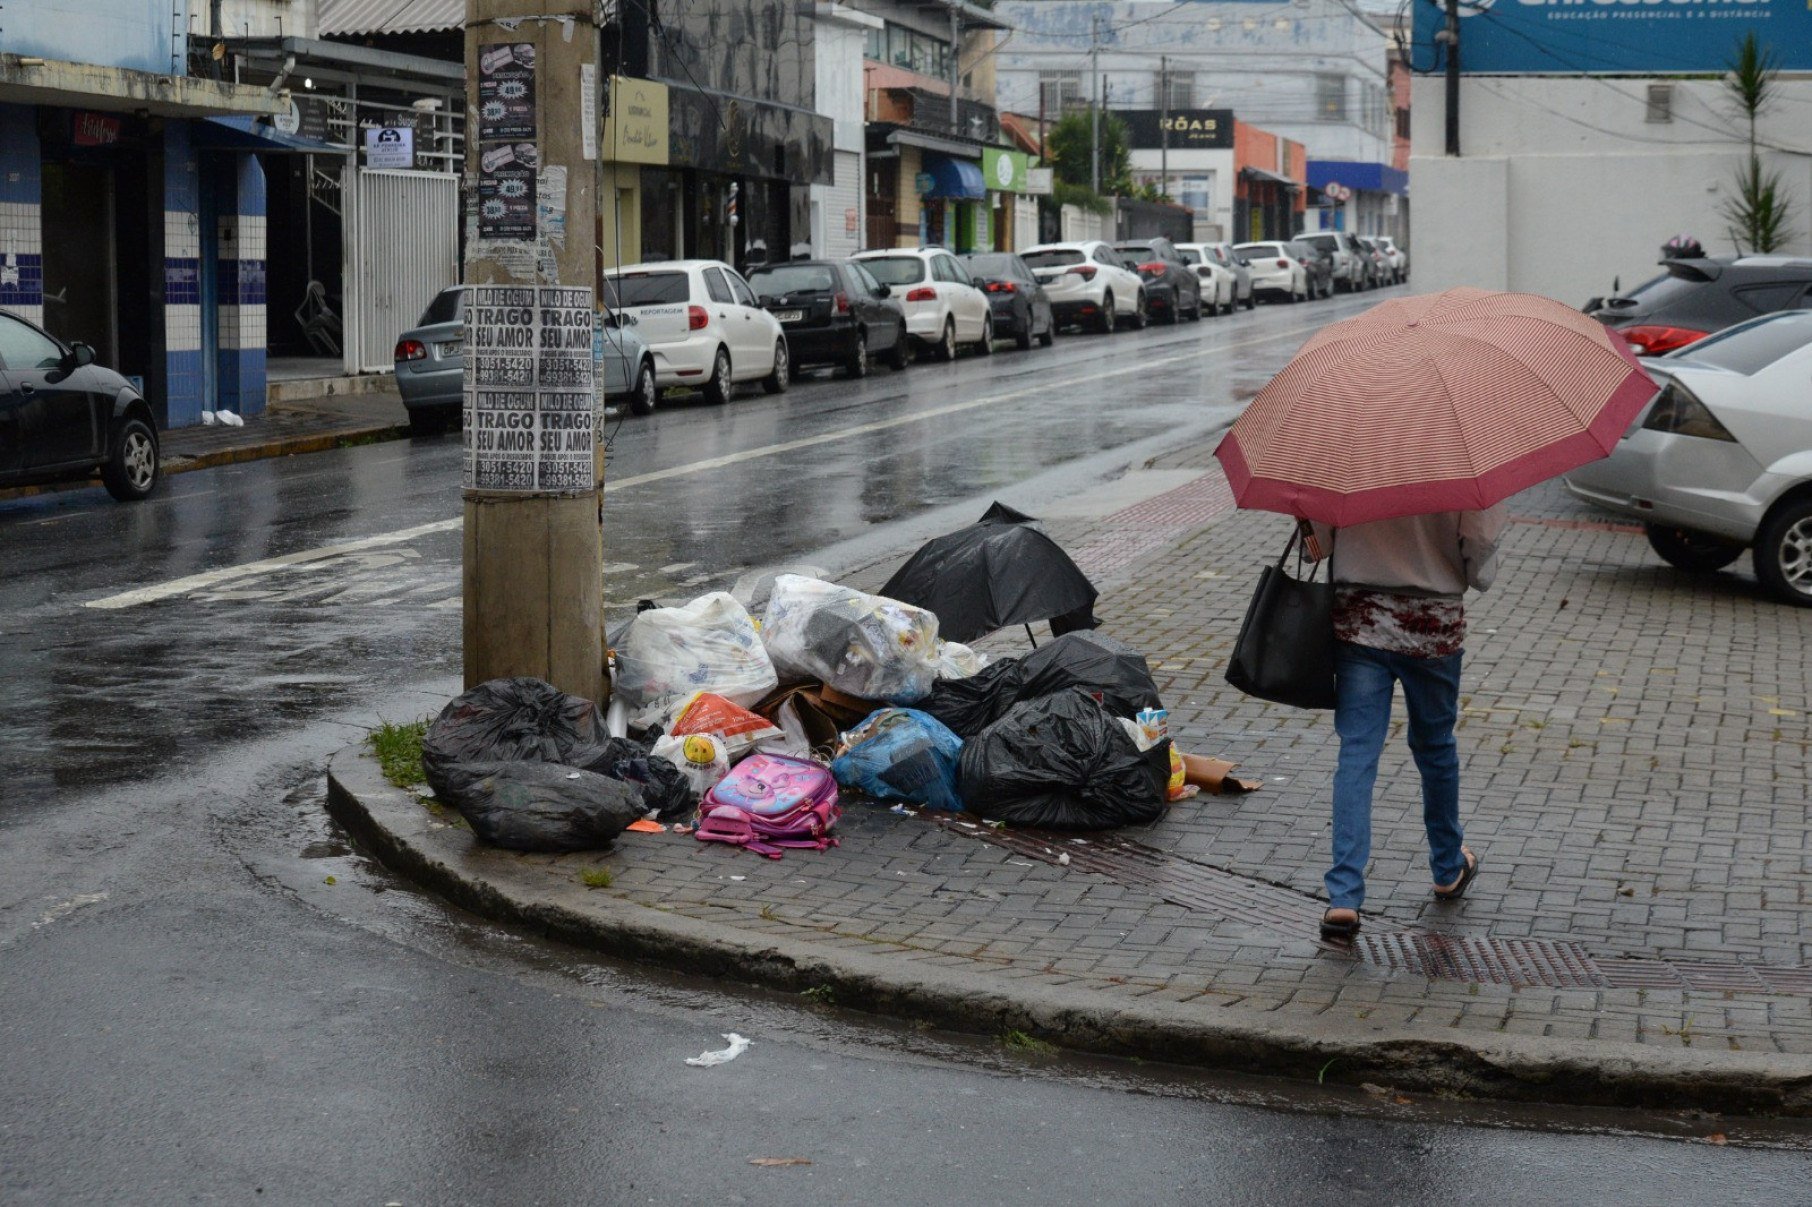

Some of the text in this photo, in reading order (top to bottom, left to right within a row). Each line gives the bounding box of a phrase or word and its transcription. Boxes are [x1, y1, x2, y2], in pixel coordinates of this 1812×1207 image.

[1547, 11, 1608, 20] EDUCAÇÃO
[1612, 10, 1681, 19] PRESENCIAL
[1686, 11, 1693, 19] E
[1709, 9, 1772, 18] DISTÂNCIA
[494, 289, 505, 306] DE
[506, 290, 533, 307] OGUM
[563, 291, 573, 307] DE
[574, 291, 591, 307] OGUM
[477, 308, 533, 325] TRAGO
[540, 309, 591, 327] TRAGO
[640, 307, 683, 316] REPORTAGEM
[477, 326, 533, 347] SEU AMOR
[540, 327, 591, 349] SEU AMOR
[480, 358, 532, 370] 3051-5420
[546, 360, 591, 371] 3051-5420
[495, 393, 505, 409] DE
[507, 394, 534, 410] OGUM
[563, 395, 573, 410] DE
[574, 395, 591, 410] OGUM
[477, 412, 534, 429] TRAGO
[540, 413, 591, 430] TRAGO
[477, 430, 534, 451] SEU AMOR
[540, 431, 591, 452] SEU AMOR
[480, 461, 533, 473] 3051-5420
[546, 462, 591, 474] 3051-5420
